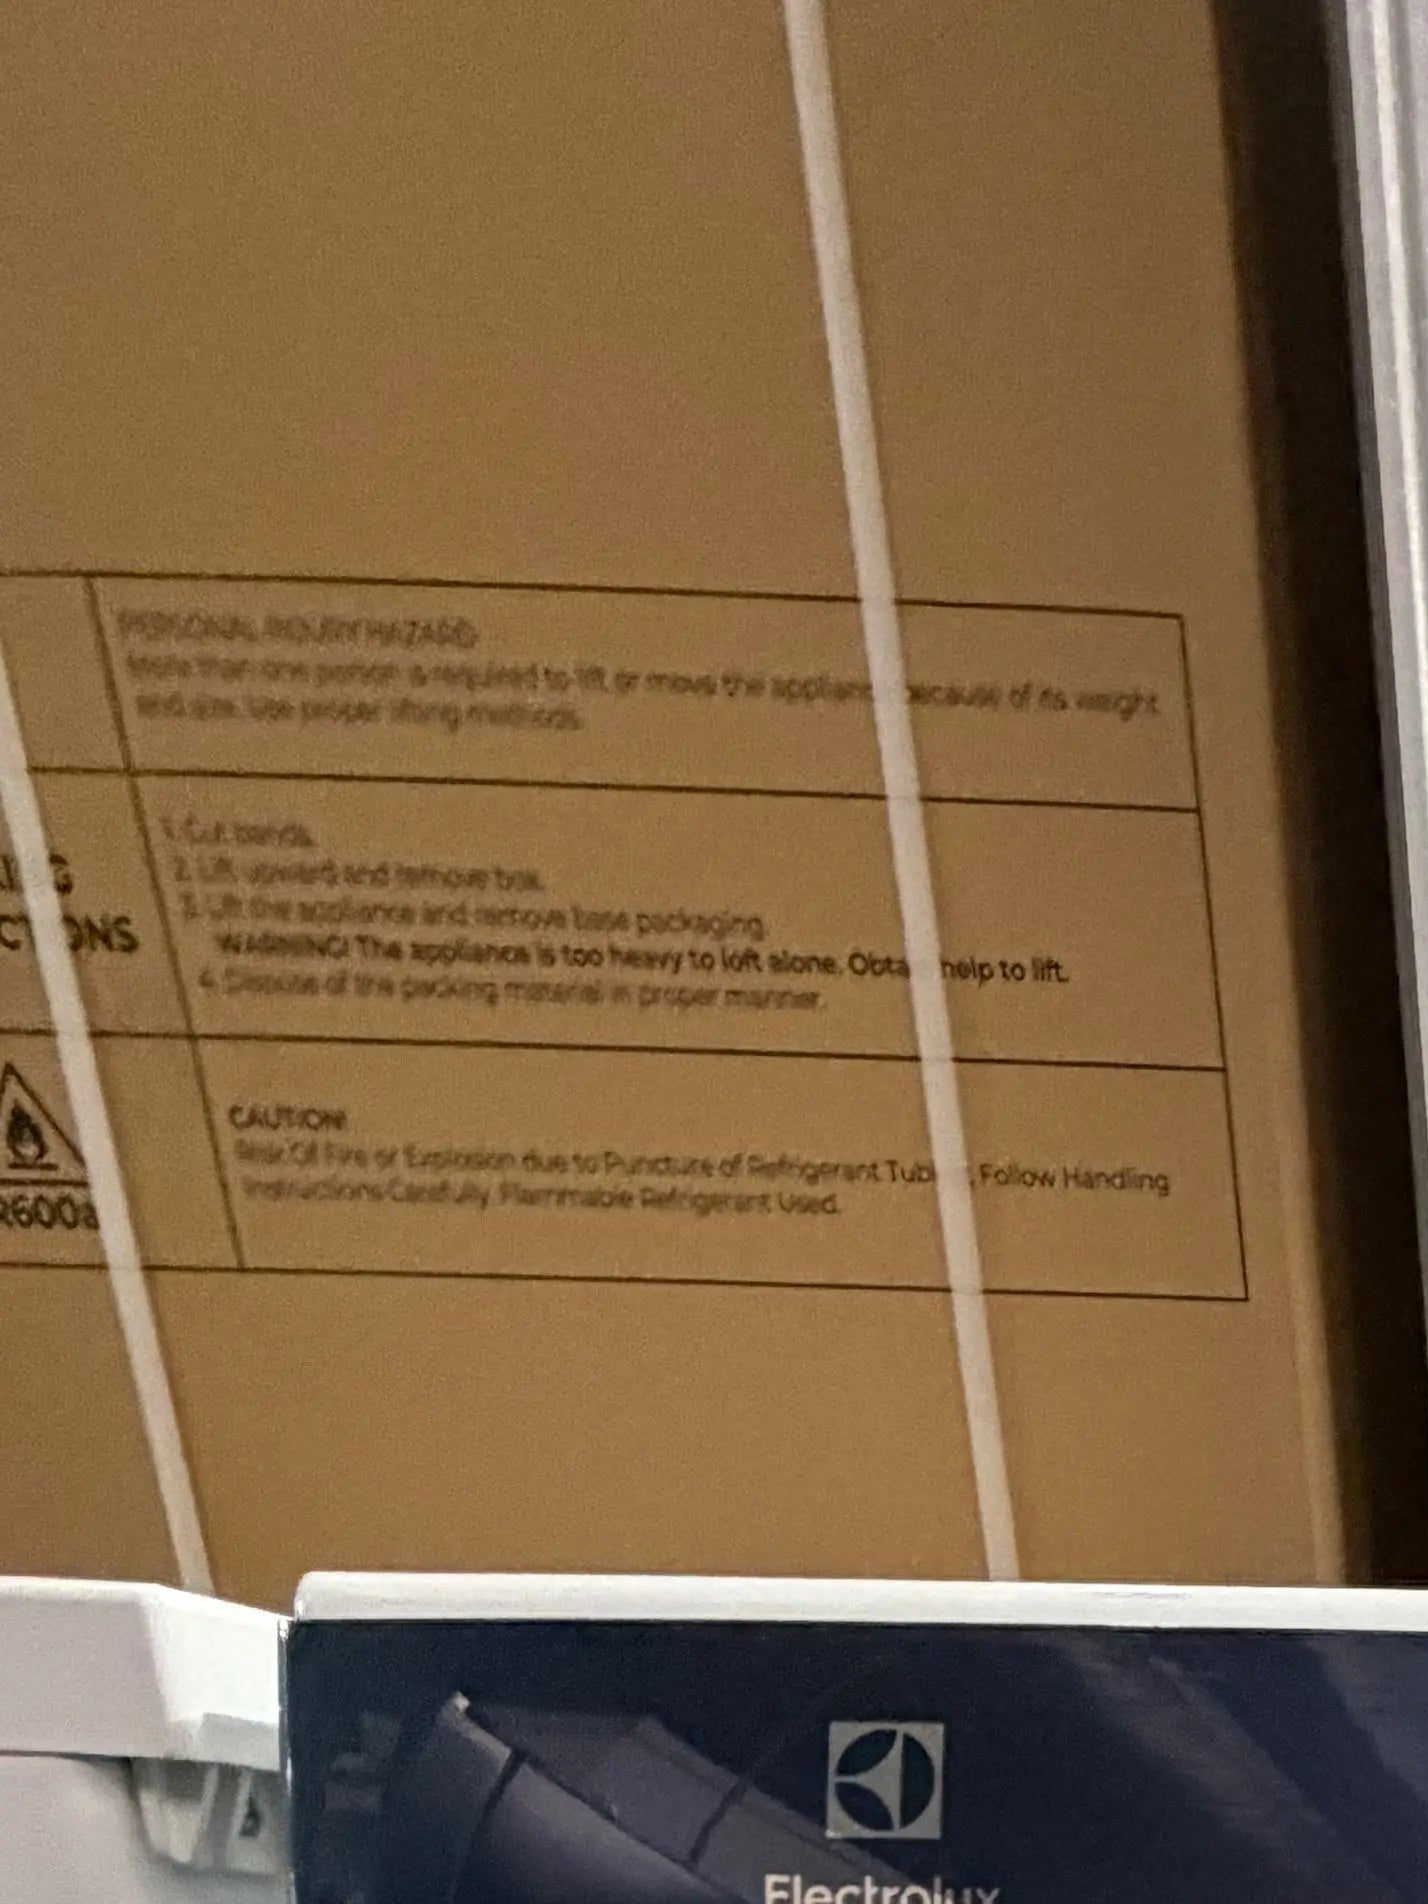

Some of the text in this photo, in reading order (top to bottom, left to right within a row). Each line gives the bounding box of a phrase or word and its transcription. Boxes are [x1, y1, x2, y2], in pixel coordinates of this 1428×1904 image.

[561, 947, 602, 968] too
[608, 947, 682, 974] heavy
[688, 950, 715, 972] to
[848, 952, 911, 979] Obta
[999, 959, 1025, 983] to
[979, 1163, 1056, 1189] Follow
[1063, 1165, 1171, 1197] Handling
